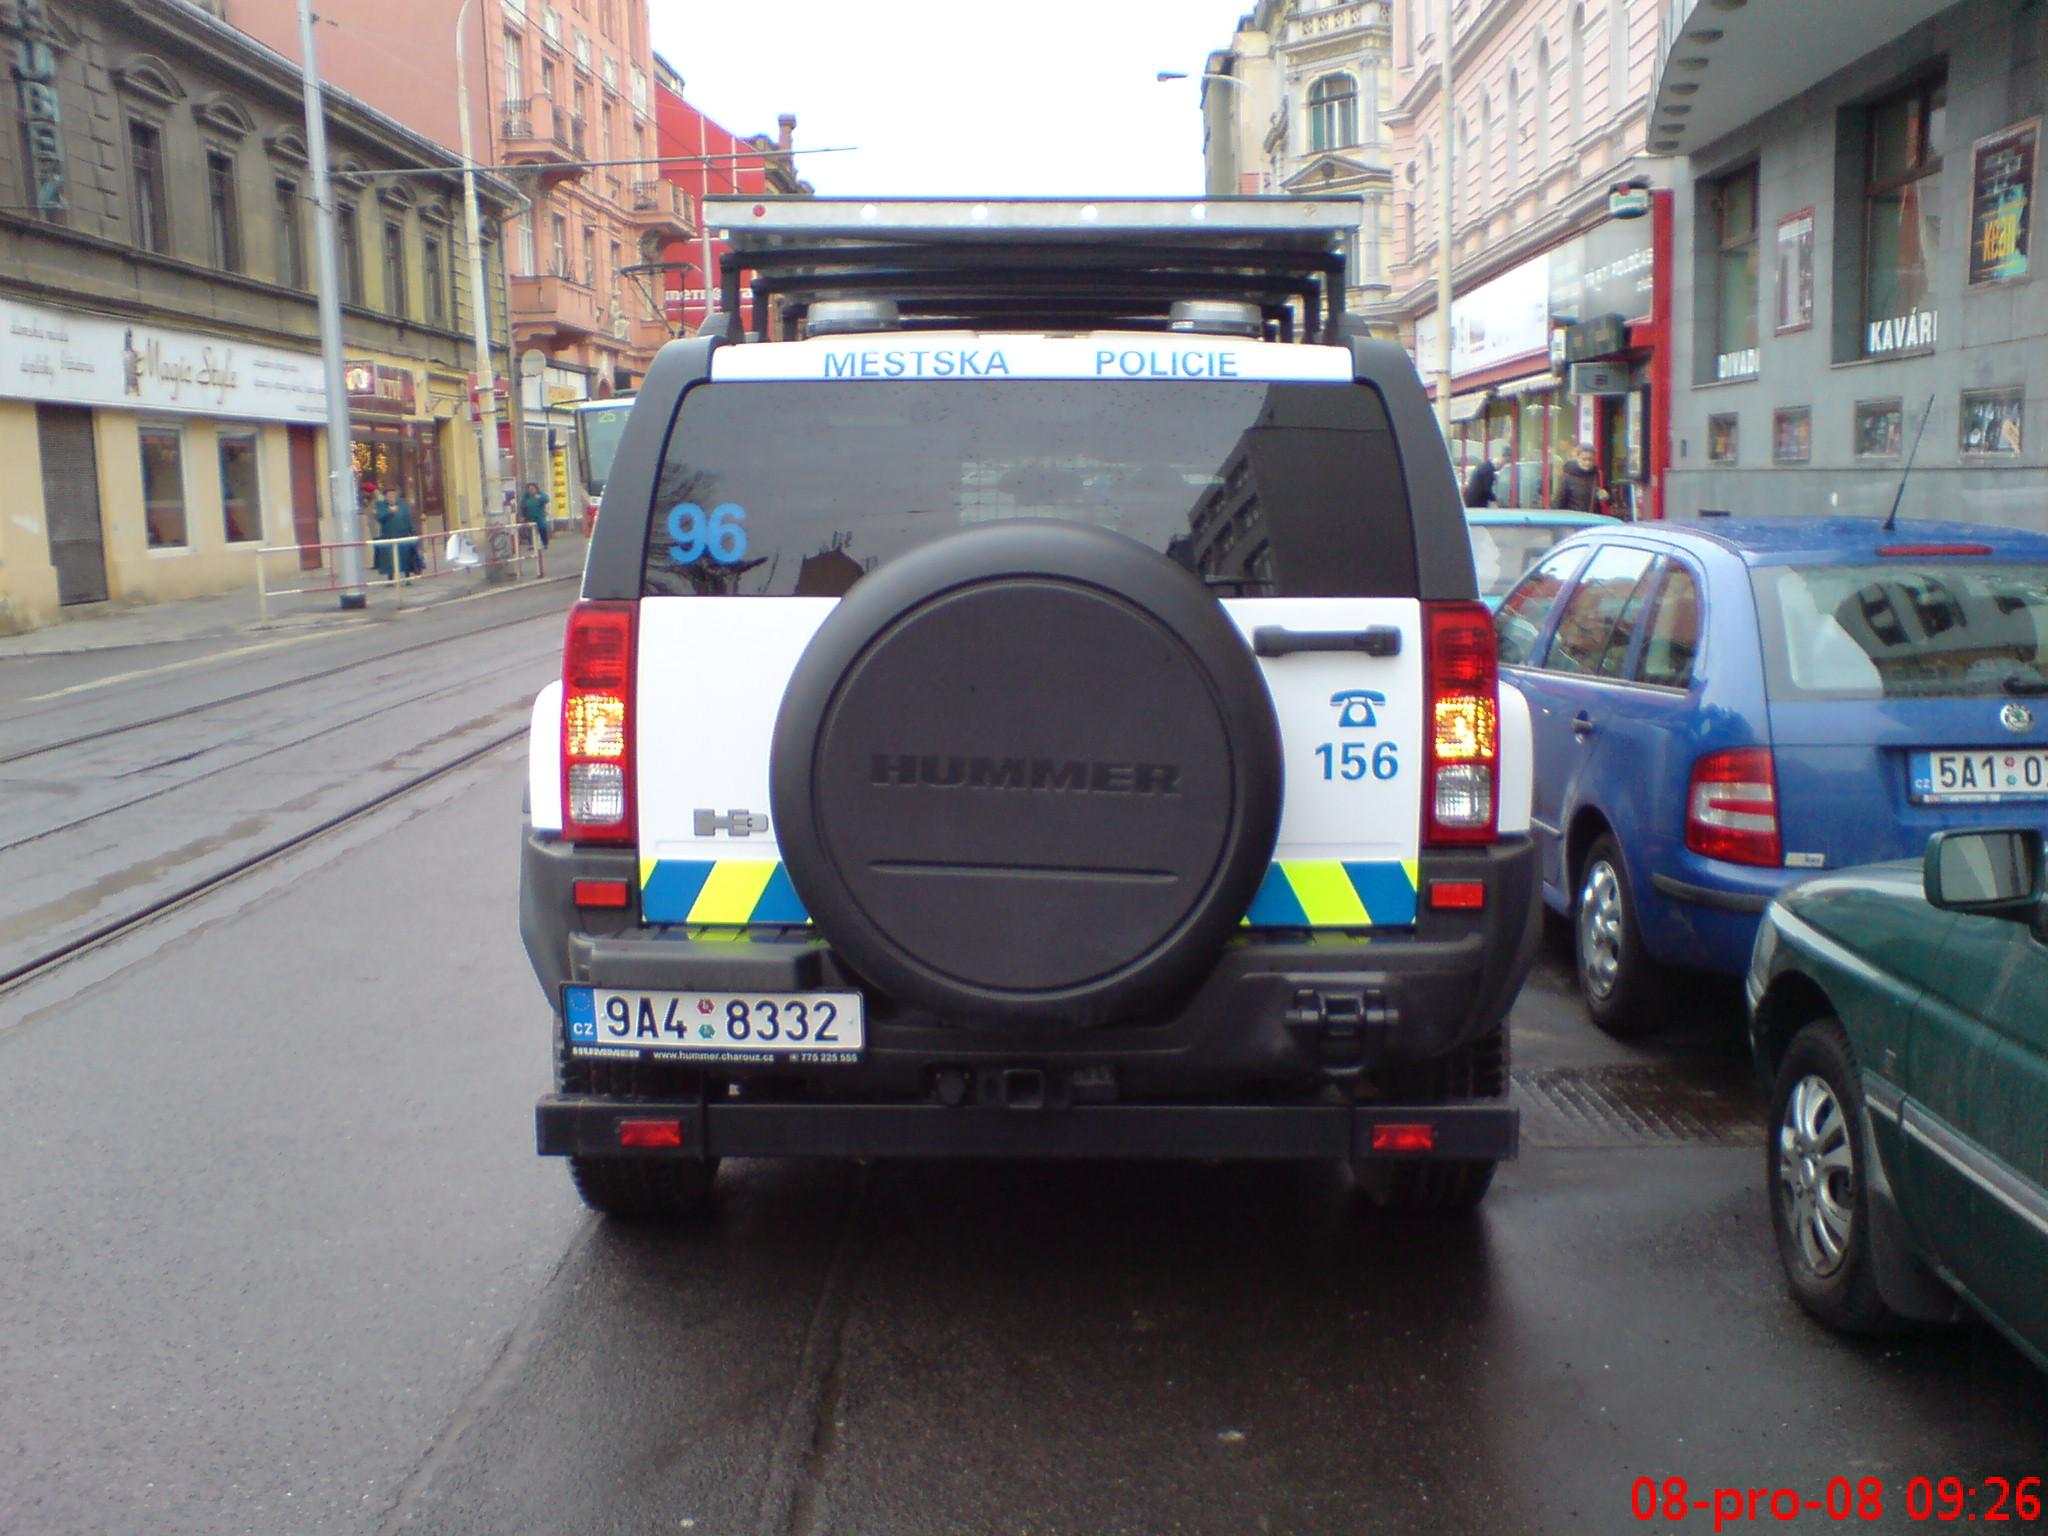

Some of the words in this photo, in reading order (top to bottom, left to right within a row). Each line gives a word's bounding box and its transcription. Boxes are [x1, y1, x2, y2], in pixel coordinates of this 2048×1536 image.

[824, 349, 1010, 378] MESTSKA
[1096, 350, 1239, 378] POLICIE
[668, 502, 748, 564] 96
[869, 754, 1183, 797] HUMMER
[1315, 741, 1399, 780] 156
[1940, 756, 1997, 788] 5A1
[573, 1022, 594, 1036] CZ
[605, 996, 688, 1039] 9A4
[726, 999, 839, 1042] 8332
